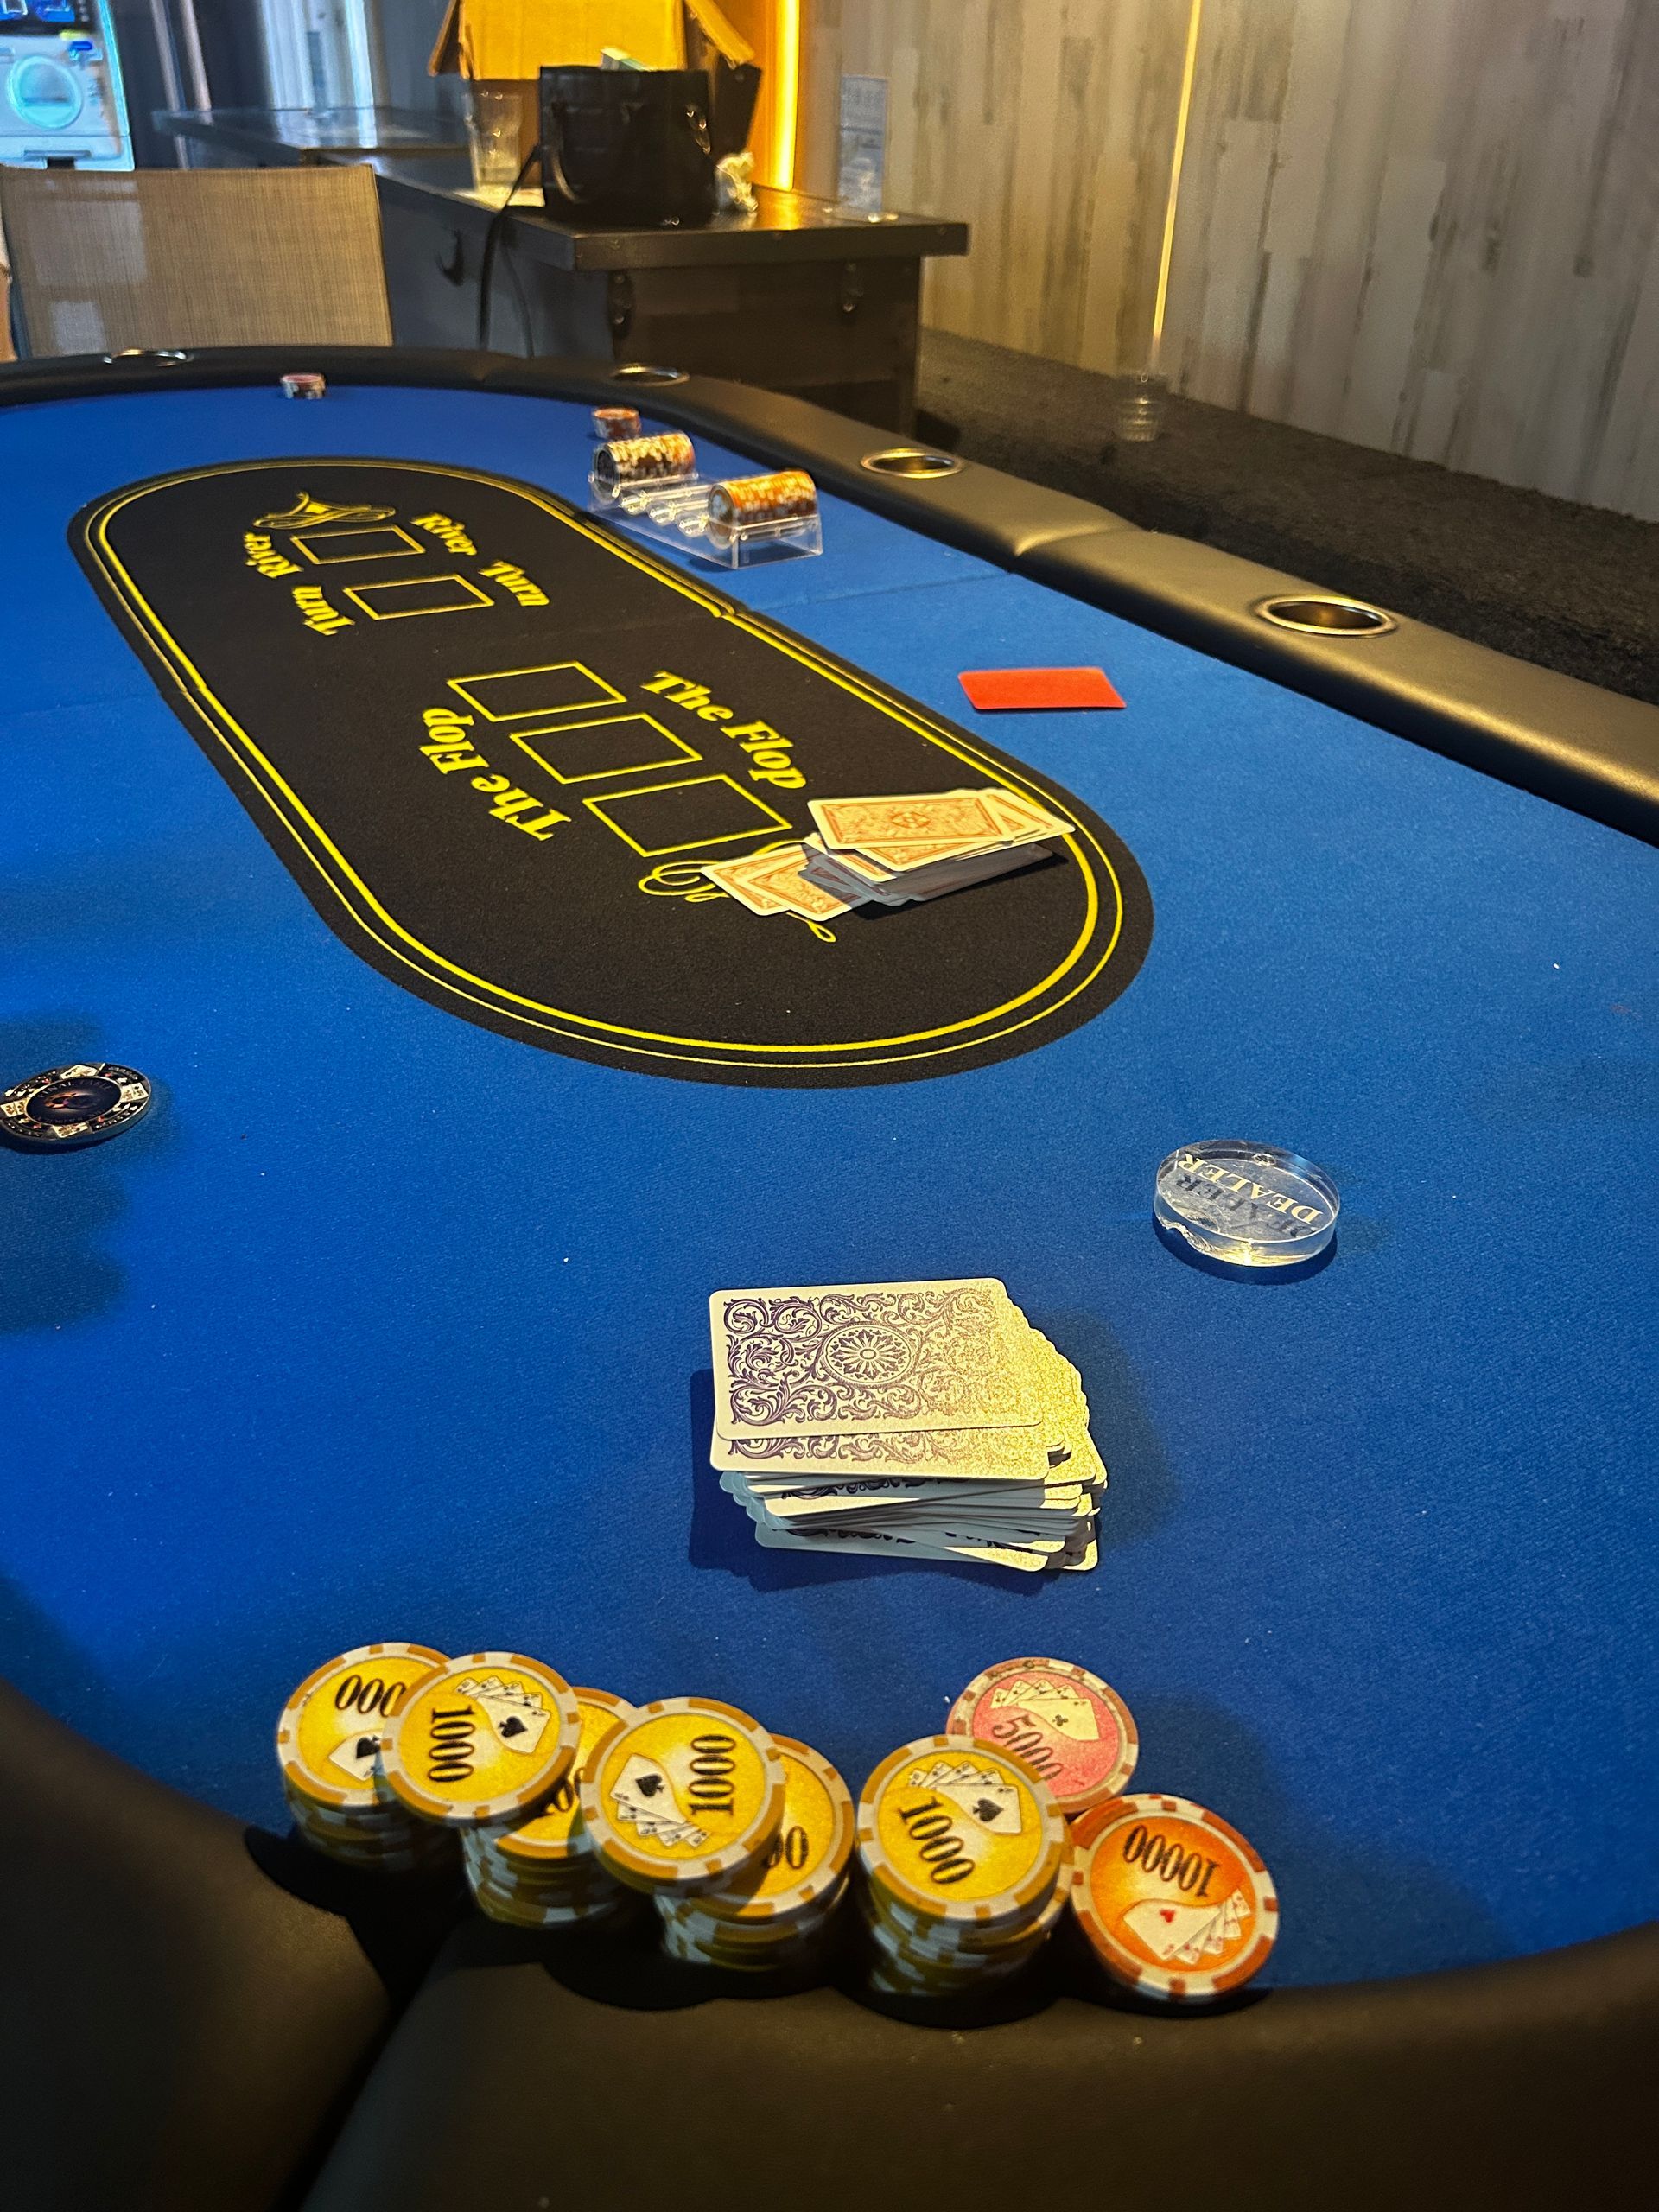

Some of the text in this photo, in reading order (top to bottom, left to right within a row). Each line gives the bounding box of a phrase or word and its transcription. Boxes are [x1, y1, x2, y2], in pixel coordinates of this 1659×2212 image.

[244, 531, 304, 579] River
[410, 512, 478, 556] River
[291, 585, 355, 636] Turn
[479, 559, 550, 607] Turn
[640, 670, 807, 789] The Flop
[419, 707, 572, 842] The Flop
[1177, 1153, 1325, 1226] DEALER
[334, 1674, 407, 1719] 000
[427, 1704, 476, 1783] 1000
[688, 1735, 736, 1816] 1000
[992, 1713, 1065, 1782] 5000
[897, 1796, 976, 1884] 1000
[1122, 1824, 1221, 1897] 10000
